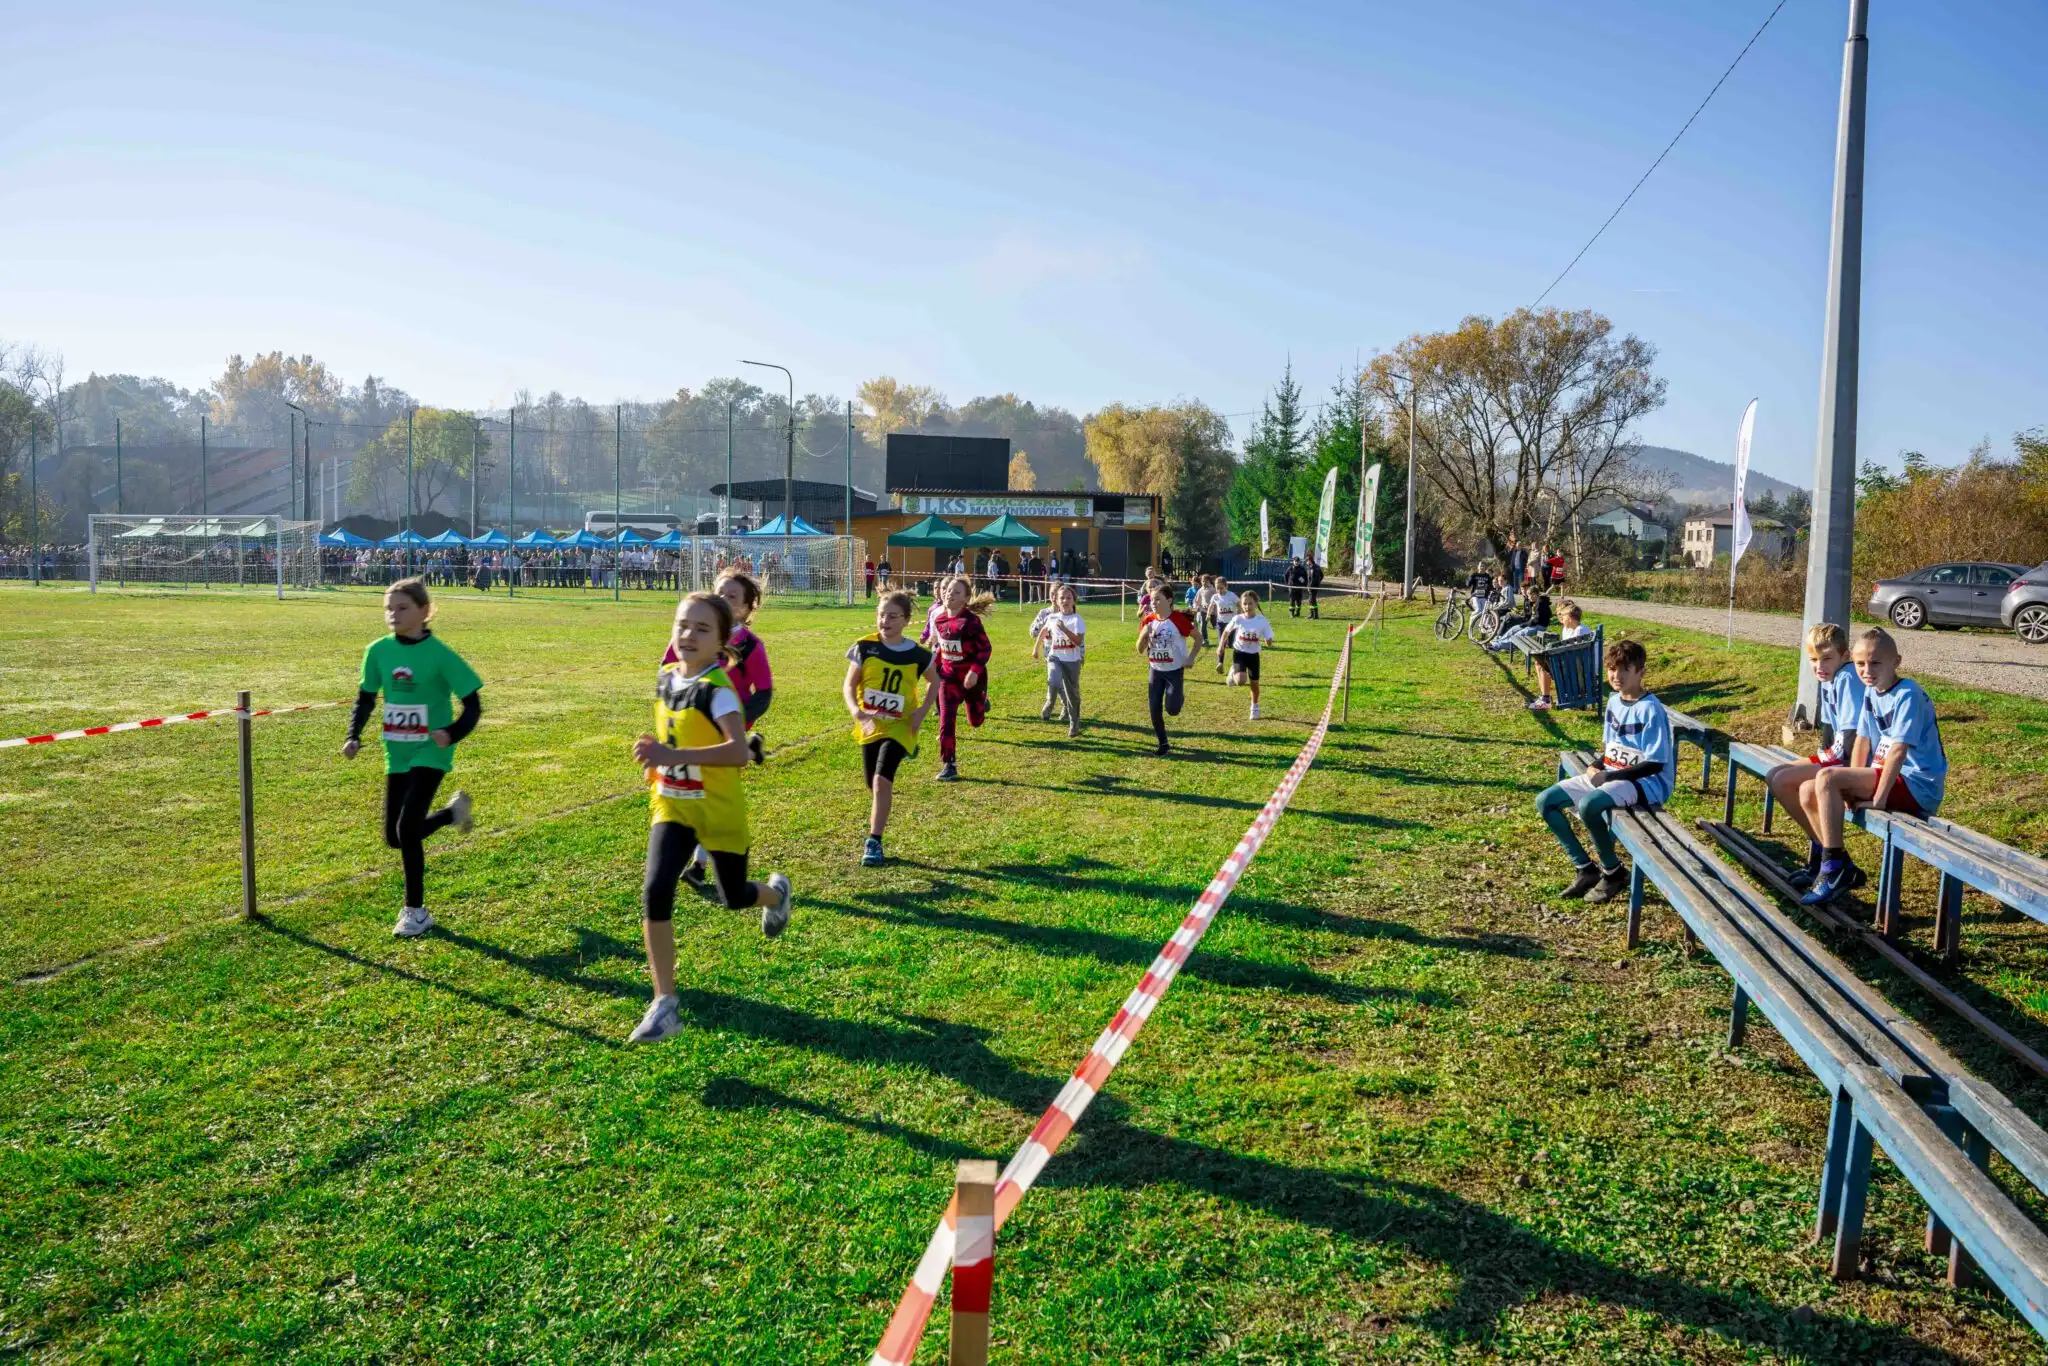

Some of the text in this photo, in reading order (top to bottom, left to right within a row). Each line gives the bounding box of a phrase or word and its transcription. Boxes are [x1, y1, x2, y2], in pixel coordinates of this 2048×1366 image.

[925, 497, 967, 514] LKS
[1152, 652, 1170, 662] 108
[880, 668, 903, 694] 10
[869, 695, 900, 713] 142
[387, 711, 421, 731] 120
[1609, 748, 1640, 766] 354
